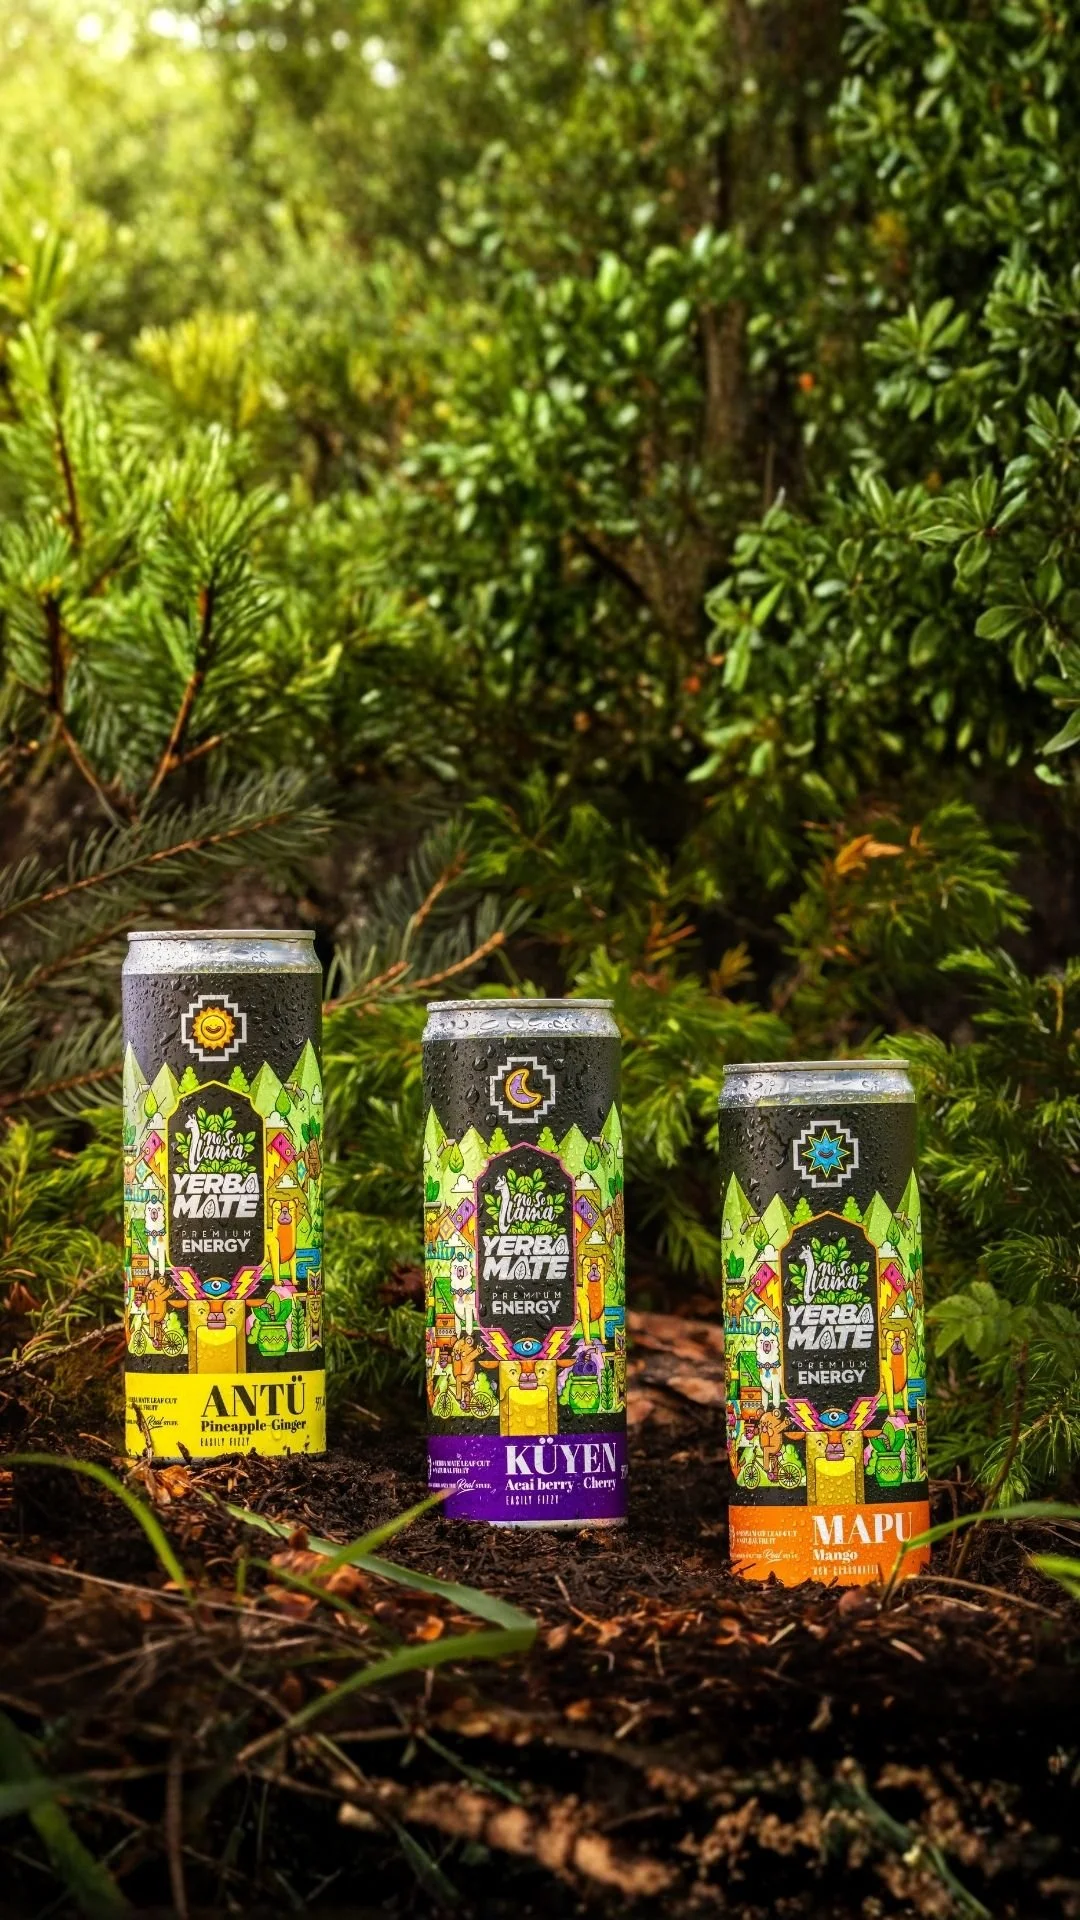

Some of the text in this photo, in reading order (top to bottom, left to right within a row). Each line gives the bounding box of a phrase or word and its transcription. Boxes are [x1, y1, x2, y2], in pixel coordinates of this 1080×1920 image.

[224, 1130, 237, 1147] Se
[172, 1173, 260, 1195] YERBA
[172, 1194, 260, 1219] MATE
[535, 1191, 547, 1208] Se
[181, 1230, 251, 1238] PREMIUM
[182, 1239, 251, 1253] ENERGY
[482, 1234, 570, 1256] YERBA
[482, 1255, 570, 1281] MATE
[840, 1261, 852, 1277] Se
[492, 1291, 561, 1300] PREMIUM
[492, 1300, 561, 1315] ENERGY
[787, 1303, 875, 1326] YERBA
[787, 1324, 875, 1350] MATE
[797, 1361, 867, 1369] PREMIUM
[798, 1369, 866, 1385] ENERGY
[200, 1375, 307, 1417] ANTÜ
[200, 1418, 307, 1435] Pineapple Ginger
[504, 1436, 617, 1476] KÜYEN
[504, 1476, 617, 1493] Acai berry Cherry
[812, 1512, 912, 1546] MAPU
[812, 1549, 859, 1564] Mango
